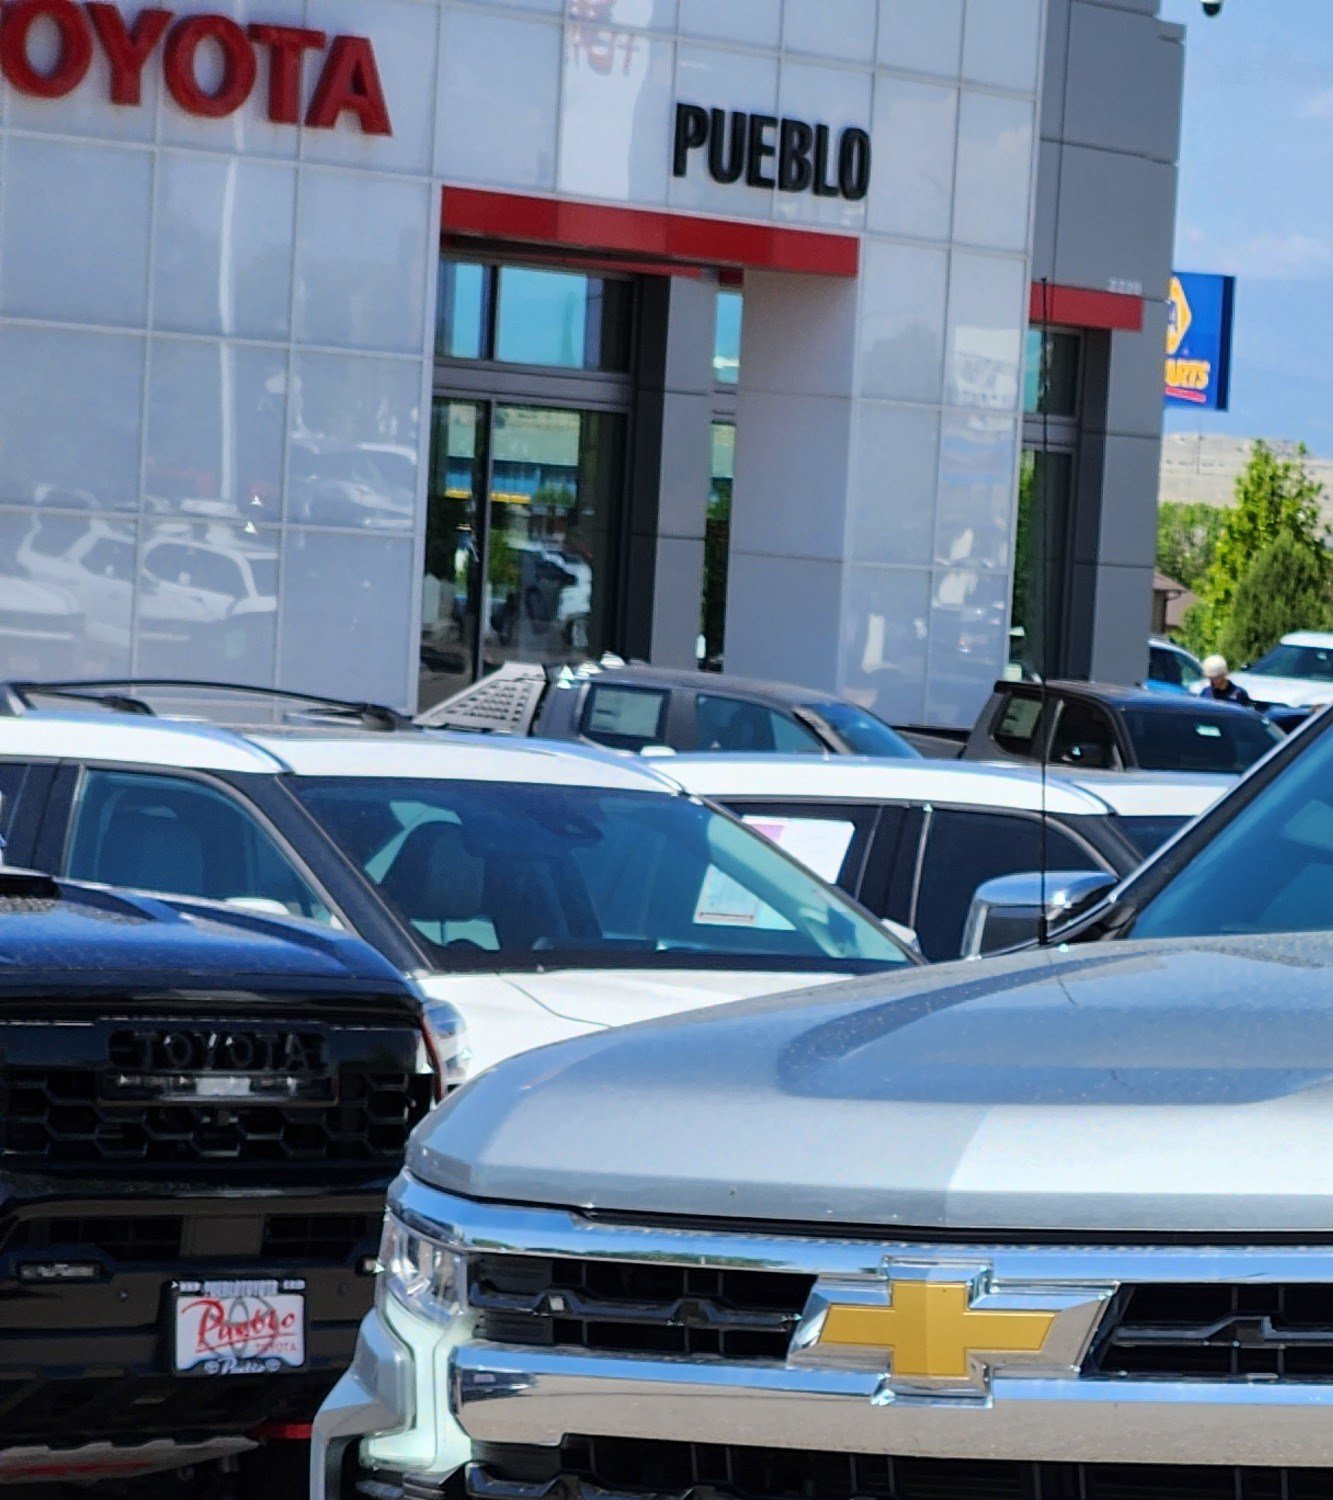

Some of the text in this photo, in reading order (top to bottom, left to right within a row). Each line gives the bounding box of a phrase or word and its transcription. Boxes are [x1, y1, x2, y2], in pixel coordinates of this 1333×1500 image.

[0, 0, 393, 137] OYOTA
[673, 102, 871, 201] PUEBLO
[133, 1030, 315, 1072] TOYOTA
